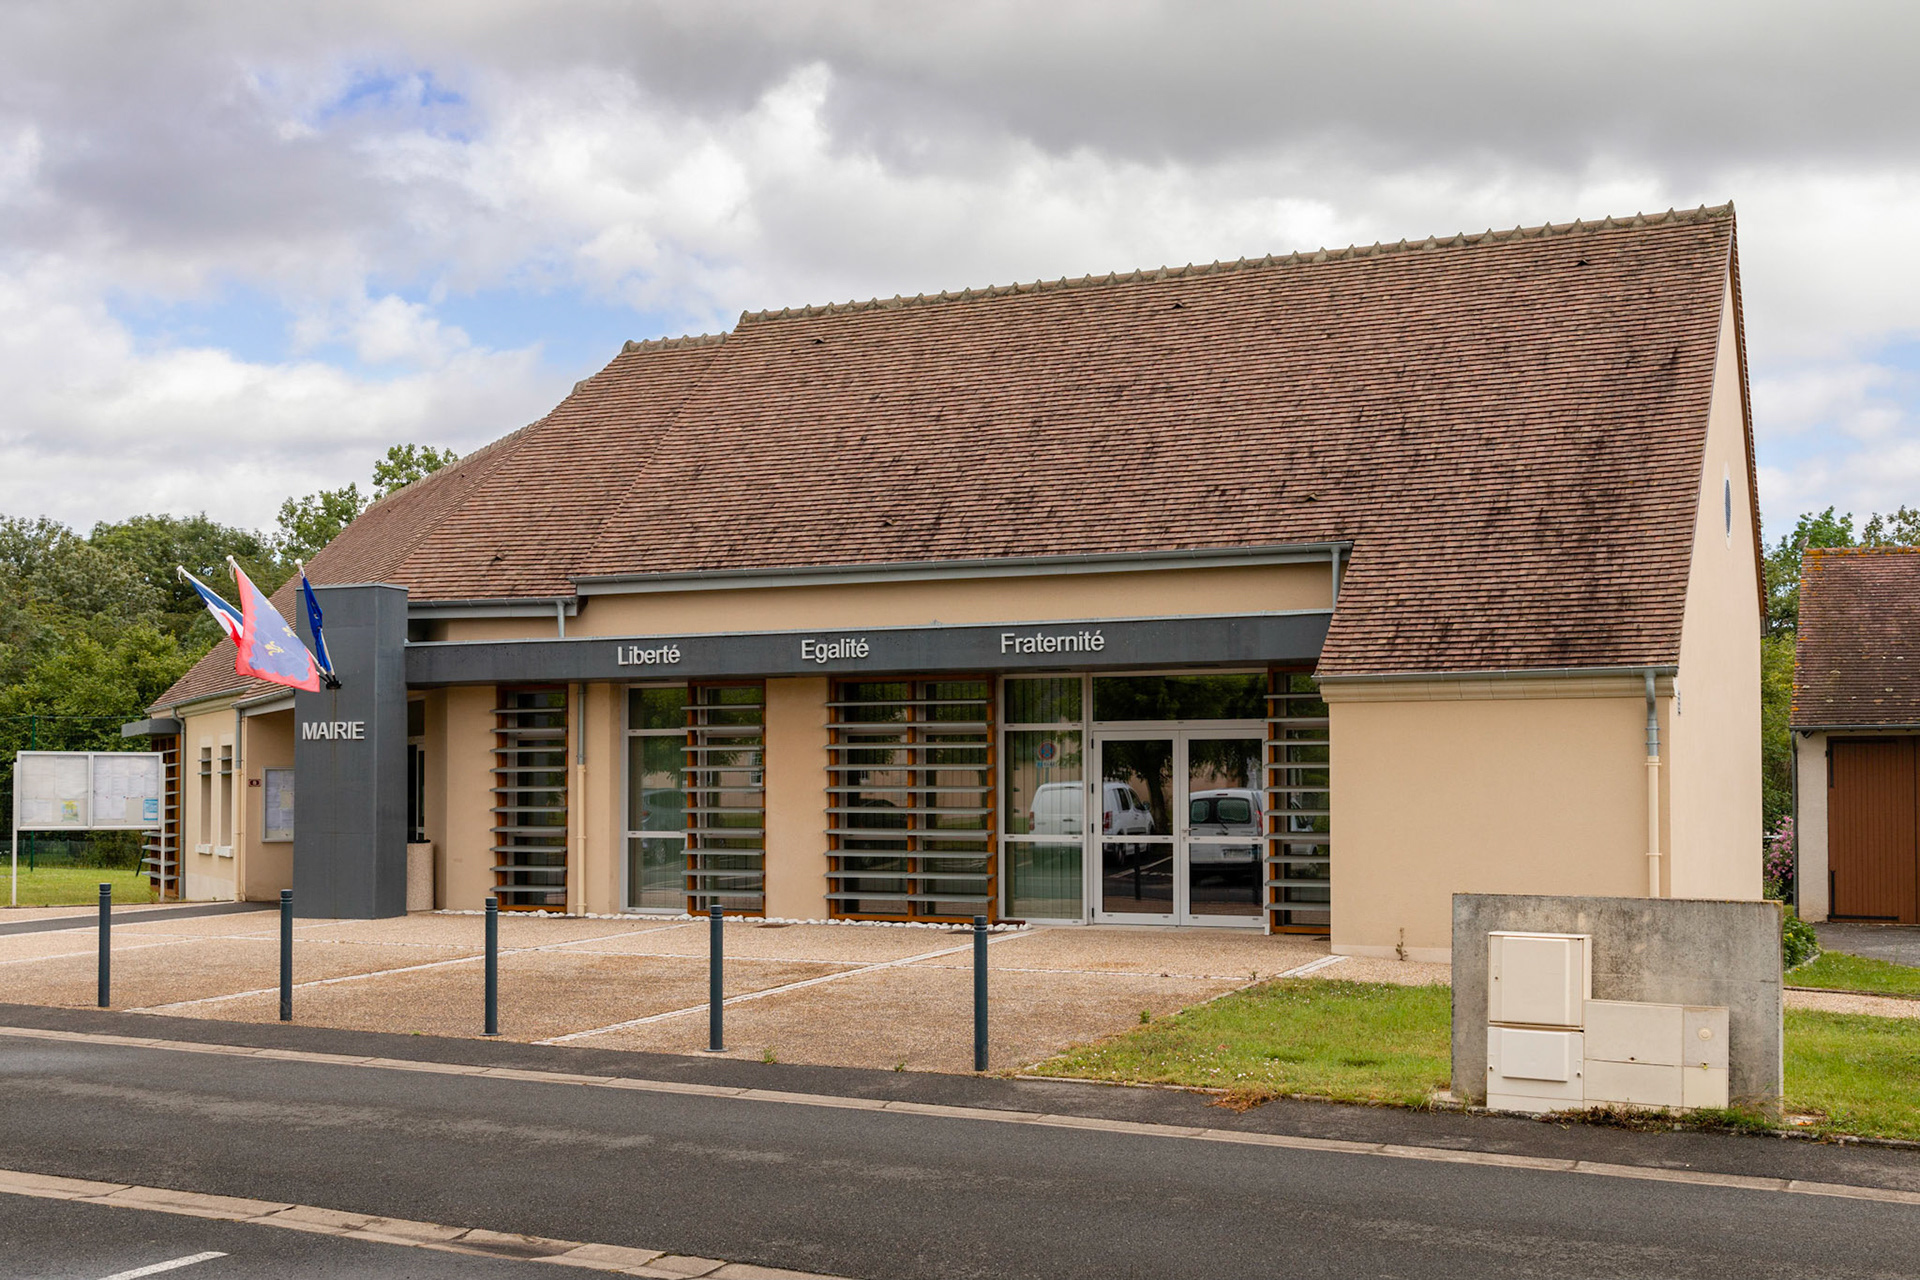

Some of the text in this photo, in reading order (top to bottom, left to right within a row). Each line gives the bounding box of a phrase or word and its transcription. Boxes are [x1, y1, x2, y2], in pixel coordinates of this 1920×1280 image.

[617, 629, 1105, 665] Liberté Egalité Fraternité
[302, 721, 365, 740] MAIRIE
